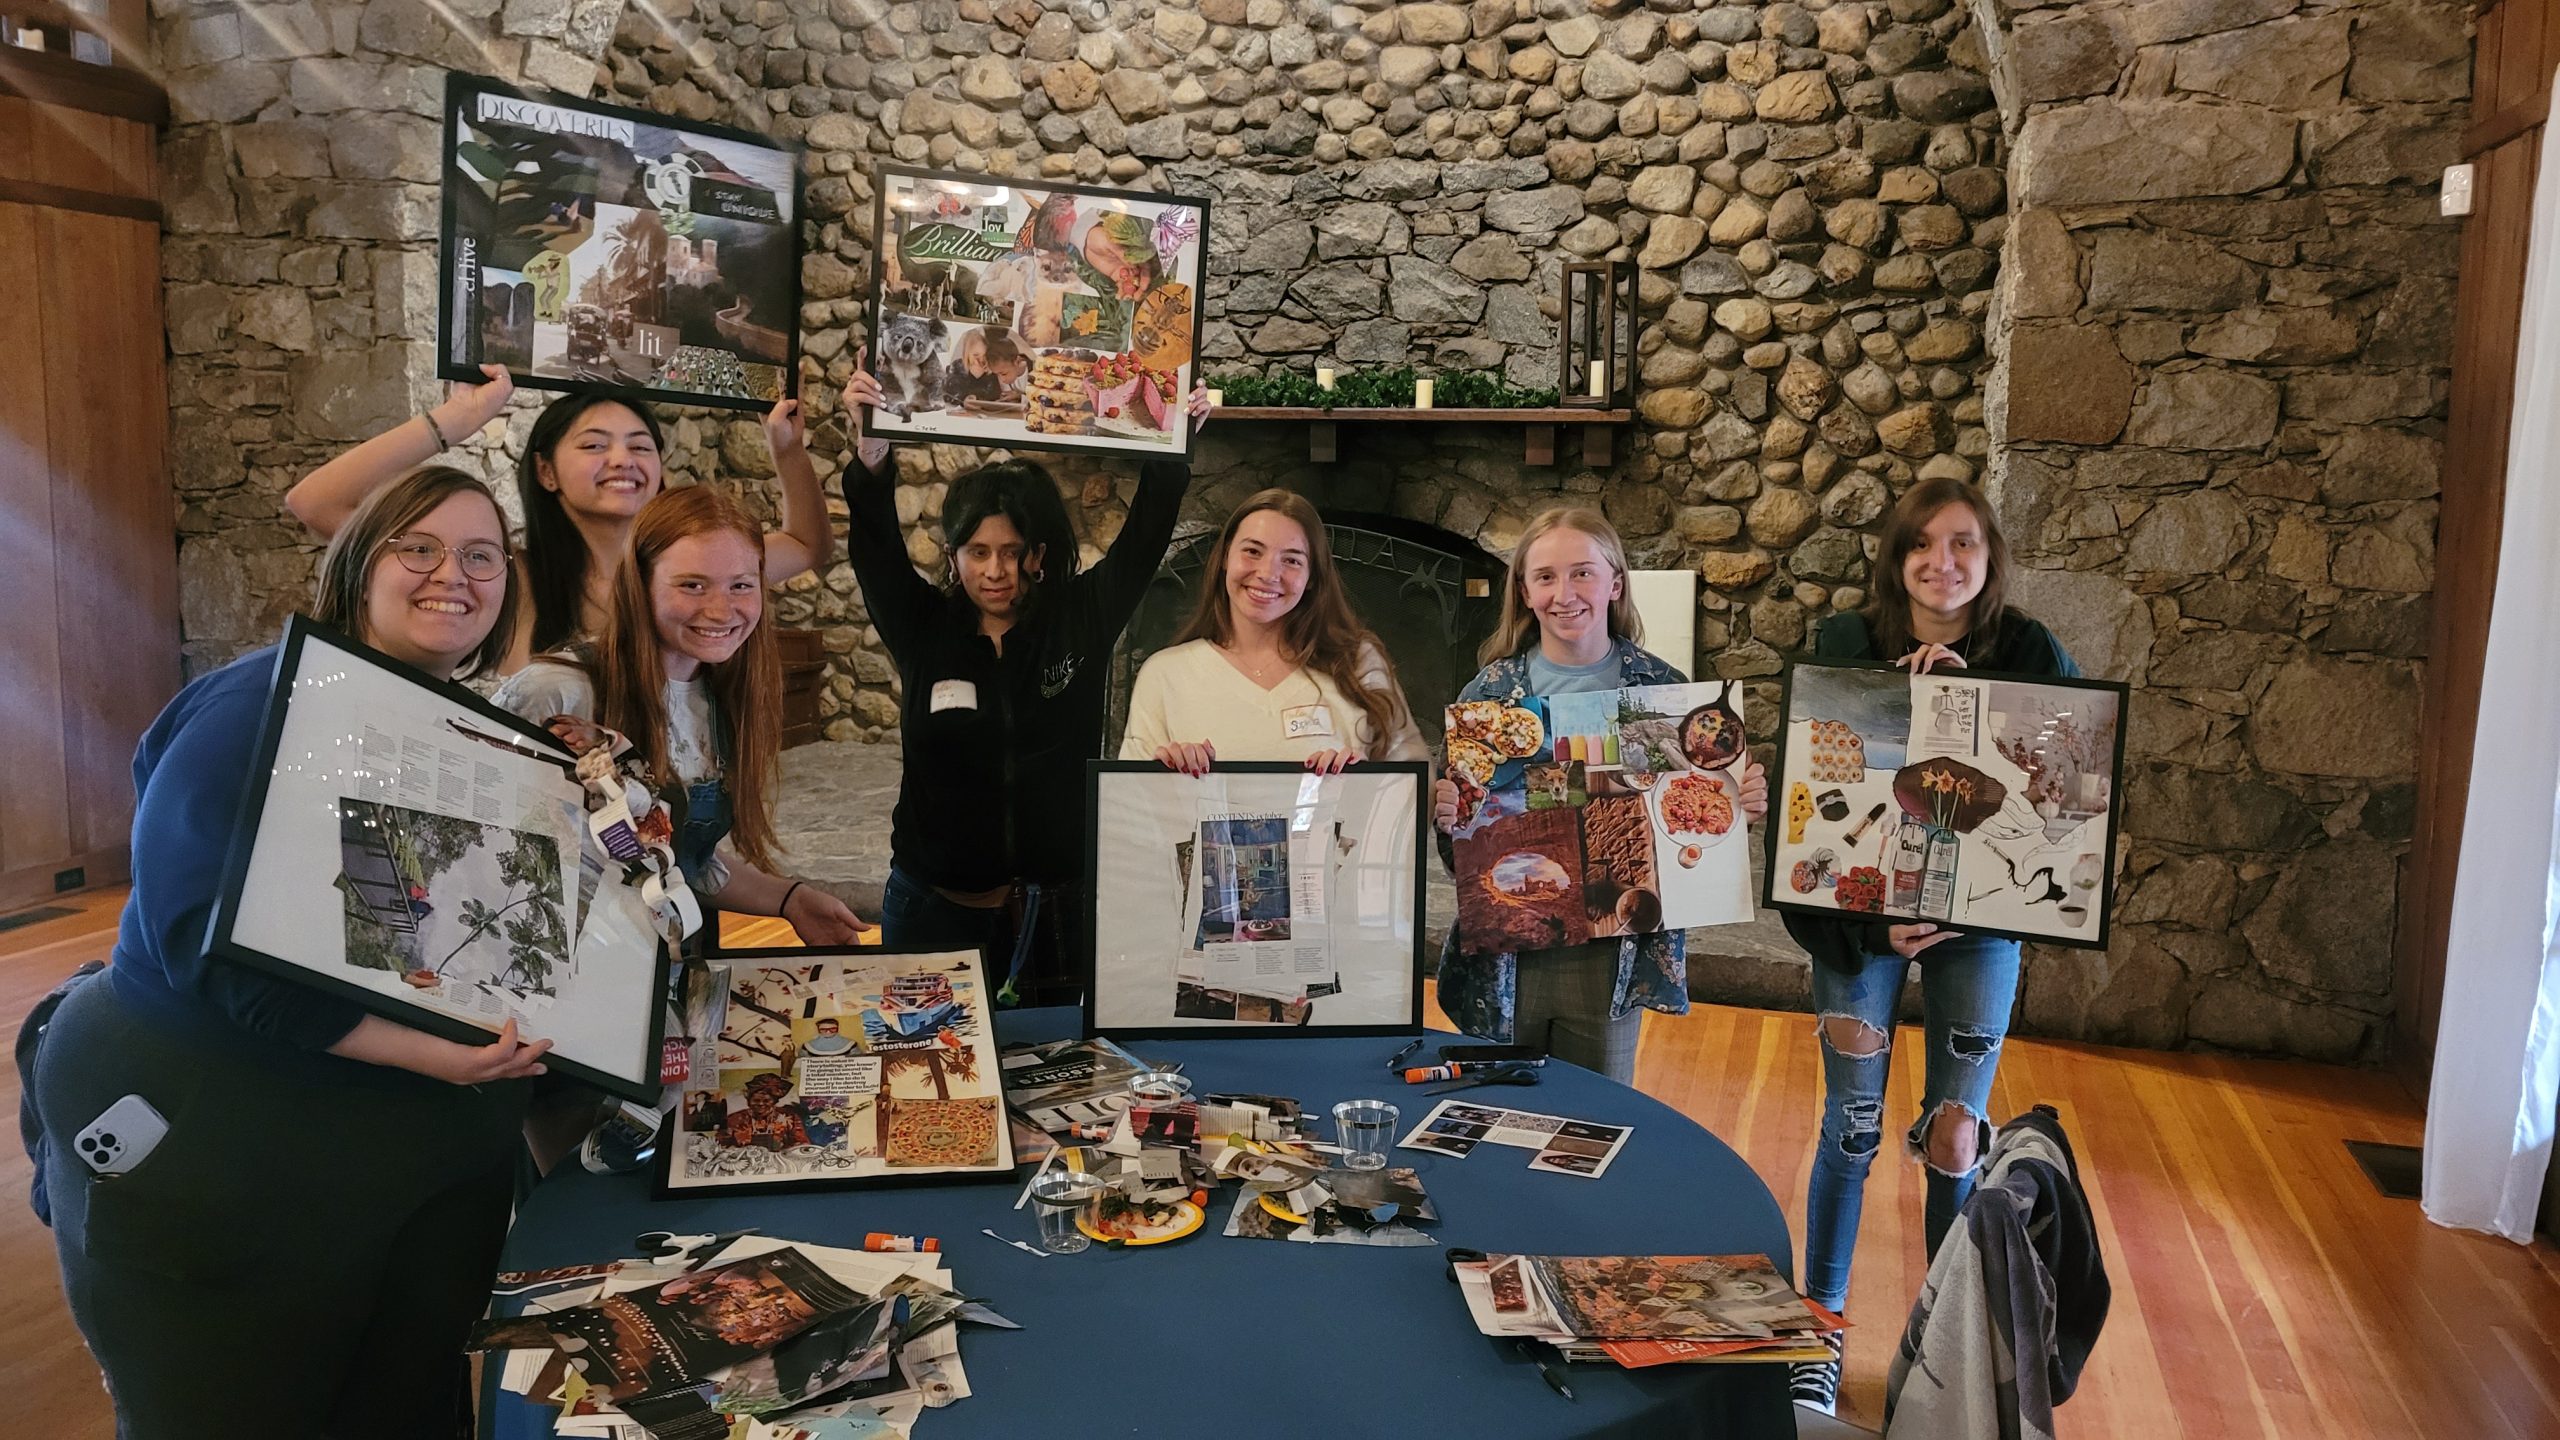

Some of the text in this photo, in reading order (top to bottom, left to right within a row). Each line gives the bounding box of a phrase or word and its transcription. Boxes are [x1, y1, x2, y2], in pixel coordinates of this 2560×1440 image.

[480, 98, 631, 140] DISCOVERIES
[720, 201, 776, 220] UNIQUE
[639, 329, 662, 356] lit
[1044, 652, 1074, 684] NIKE
[867, 1038, 932, 1052] Testosterone
[664, 1052, 688, 1064] THE
[1019, 1064, 1107, 1085] RESORTS
